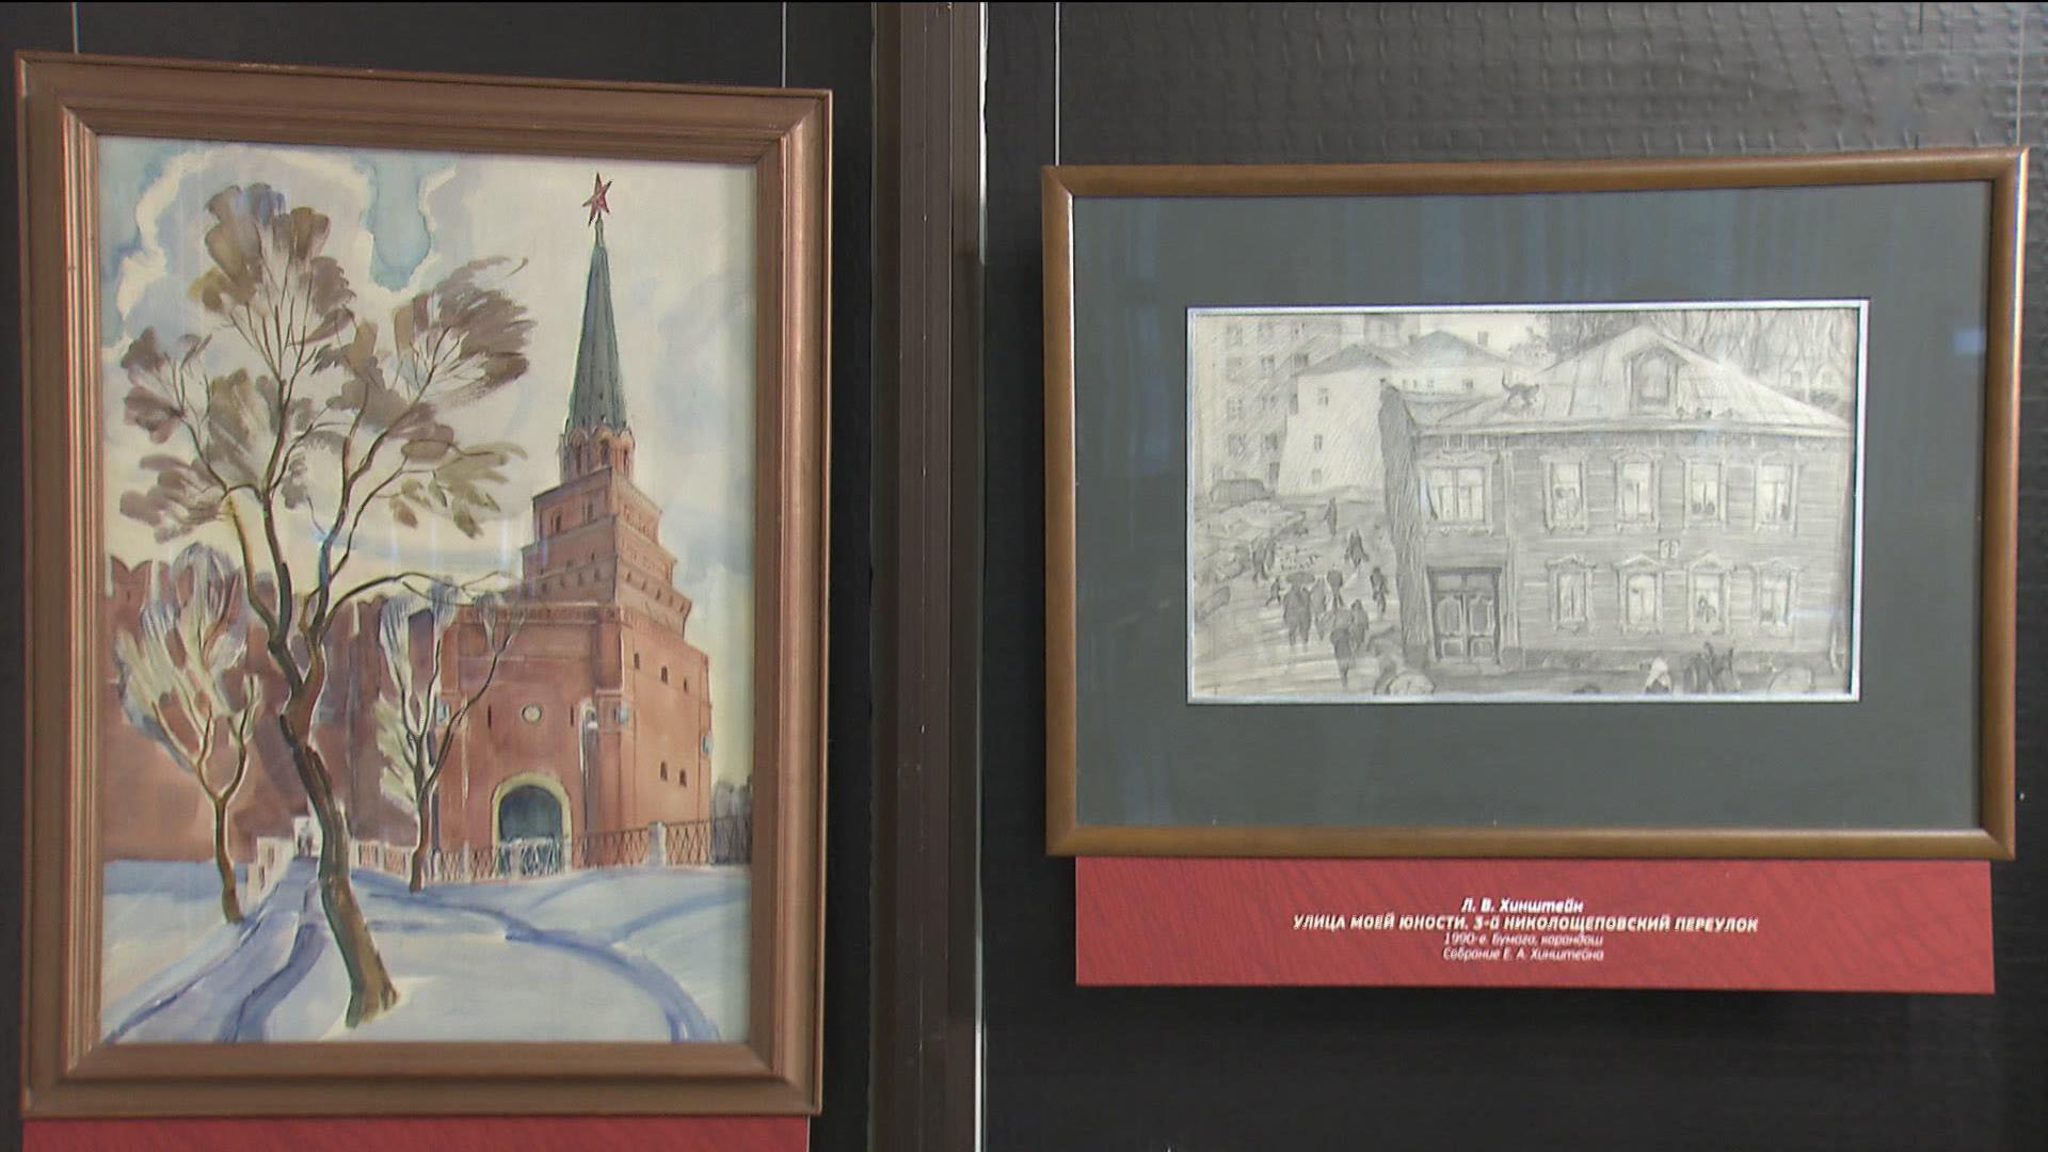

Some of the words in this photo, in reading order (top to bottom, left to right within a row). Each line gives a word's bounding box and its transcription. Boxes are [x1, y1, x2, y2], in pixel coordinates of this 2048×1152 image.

[1461, 897, 1476, 912] Л.
[1481, 897, 1495, 912] В.
[1499, 897, 1585, 913] Хинштейн
[1292, 914, 1346, 931] УЛИЦА
[1350, 911, 1395, 930] МОЕЙ
[1399, 914, 1469, 930] ЮНОСТИ.
[1503, 913, 1671, 934] НИКОЛОЩЕПОВСКИЙ
[1675, 915, 1759, 933] ПЕРЕУЛОК
[1540, 931, 1604, 948] карандаш
[1443, 947, 1500, 962] Собрание
[1530, 947, 1605, 962] Хинштейна
